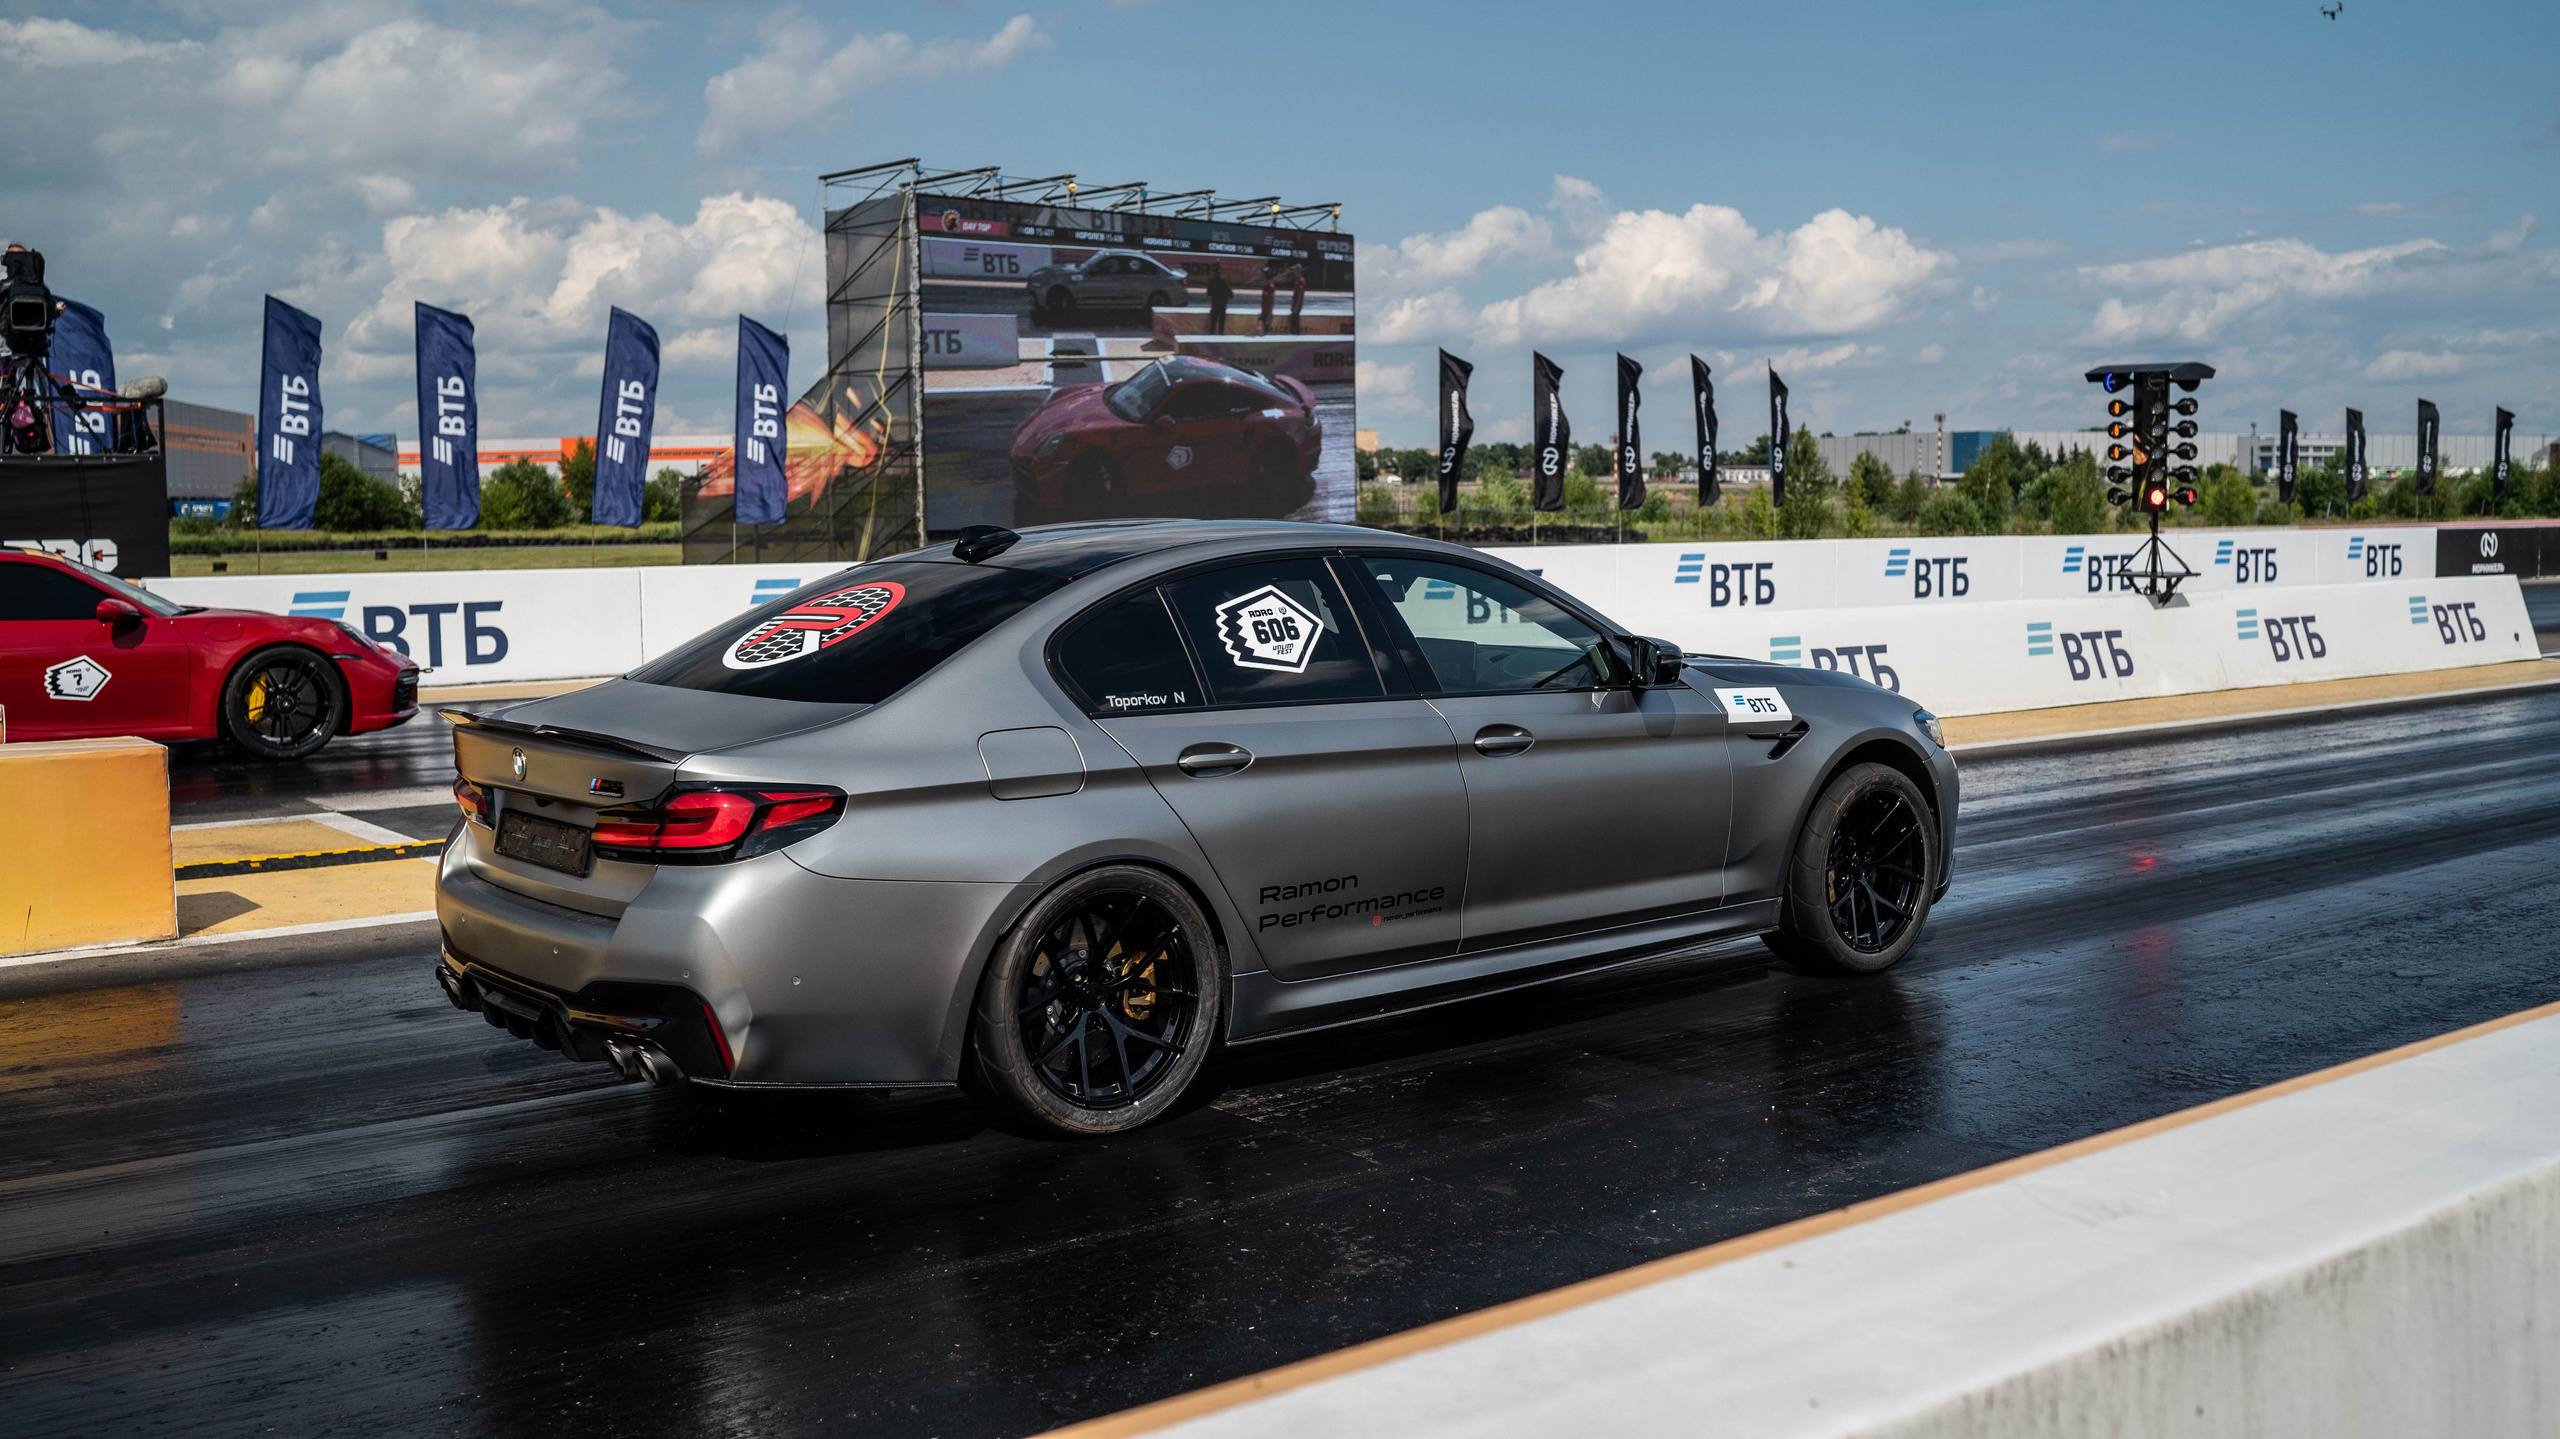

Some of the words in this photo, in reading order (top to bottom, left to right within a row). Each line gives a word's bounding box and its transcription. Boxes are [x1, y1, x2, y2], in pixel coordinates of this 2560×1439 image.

[983, 254, 1019, 274] ВТБ
[281, 374, 309, 437] ВТБ
[437, 375, 466, 437] ВТБ
[615, 379, 645, 438] ВТБ
[753, 383, 779, 439] ВТБ
[1914, 557, 1969, 598] ВТБ
[2088, 555, 2134, 592] ВТБ
[2237, 547, 2277, 583] ВТБ
[2366, 544, 2402, 577] ВТБ
[1711, 562, 1776, 607] ВТБ
[1248, 608, 1274, 618] RDRC
[1252, 616, 1301, 645] 606
[2432, 602, 2486, 644] ВТБ
[363, 601, 508, 668] ВТБ
[2264, 615, 2326, 663] ВТБ
[2060, 629, 2134, 681] ВТБ
[73, 673, 82, 686] 7
[1105, 693, 1168, 711] Toporkov
[1173, 691, 1186, 704] N
[1746, 698, 1778, 713] ВТБ
[1259, 875, 1359, 905] Ramon
[1259, 886, 1445, 933] Performance
[1383, 906, 1443, 922] ramon_performance
